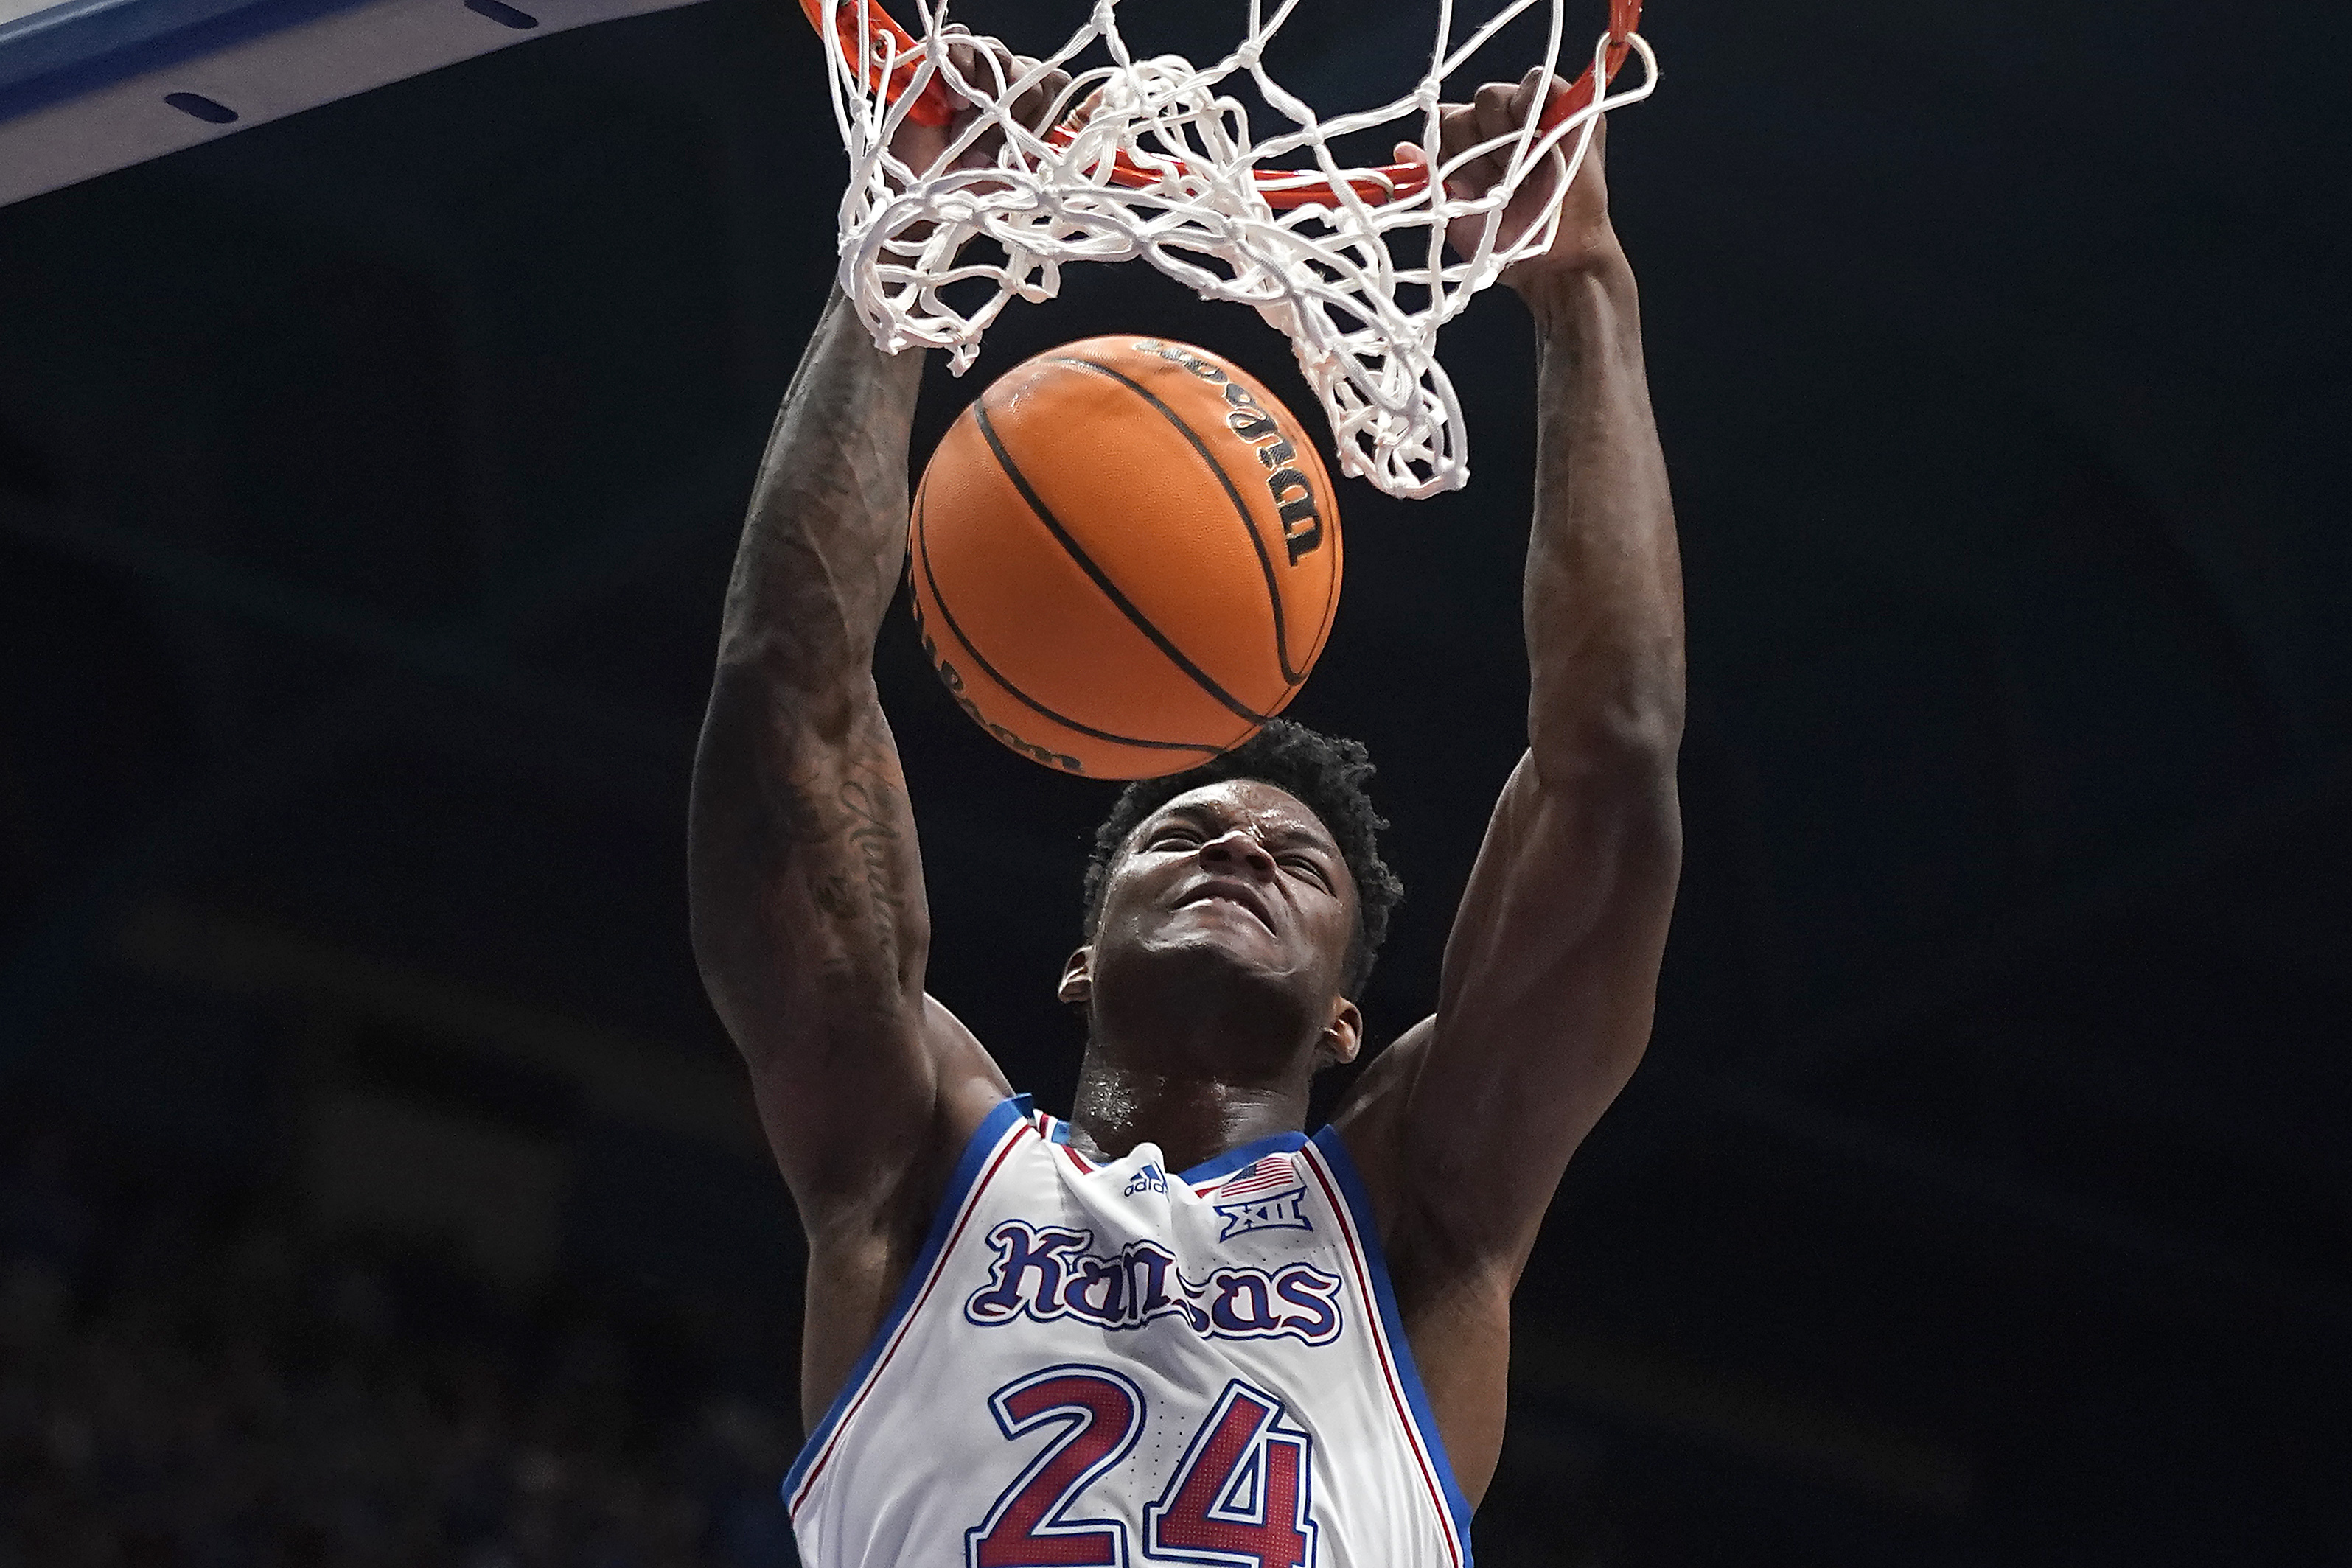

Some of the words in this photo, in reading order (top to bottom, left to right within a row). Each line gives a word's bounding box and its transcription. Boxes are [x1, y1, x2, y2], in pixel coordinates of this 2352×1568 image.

[1124, 1178, 1170, 1198] adid
[1213, 1186, 1313, 1243] XII
[964, 1363, 1319, 1568] 24
